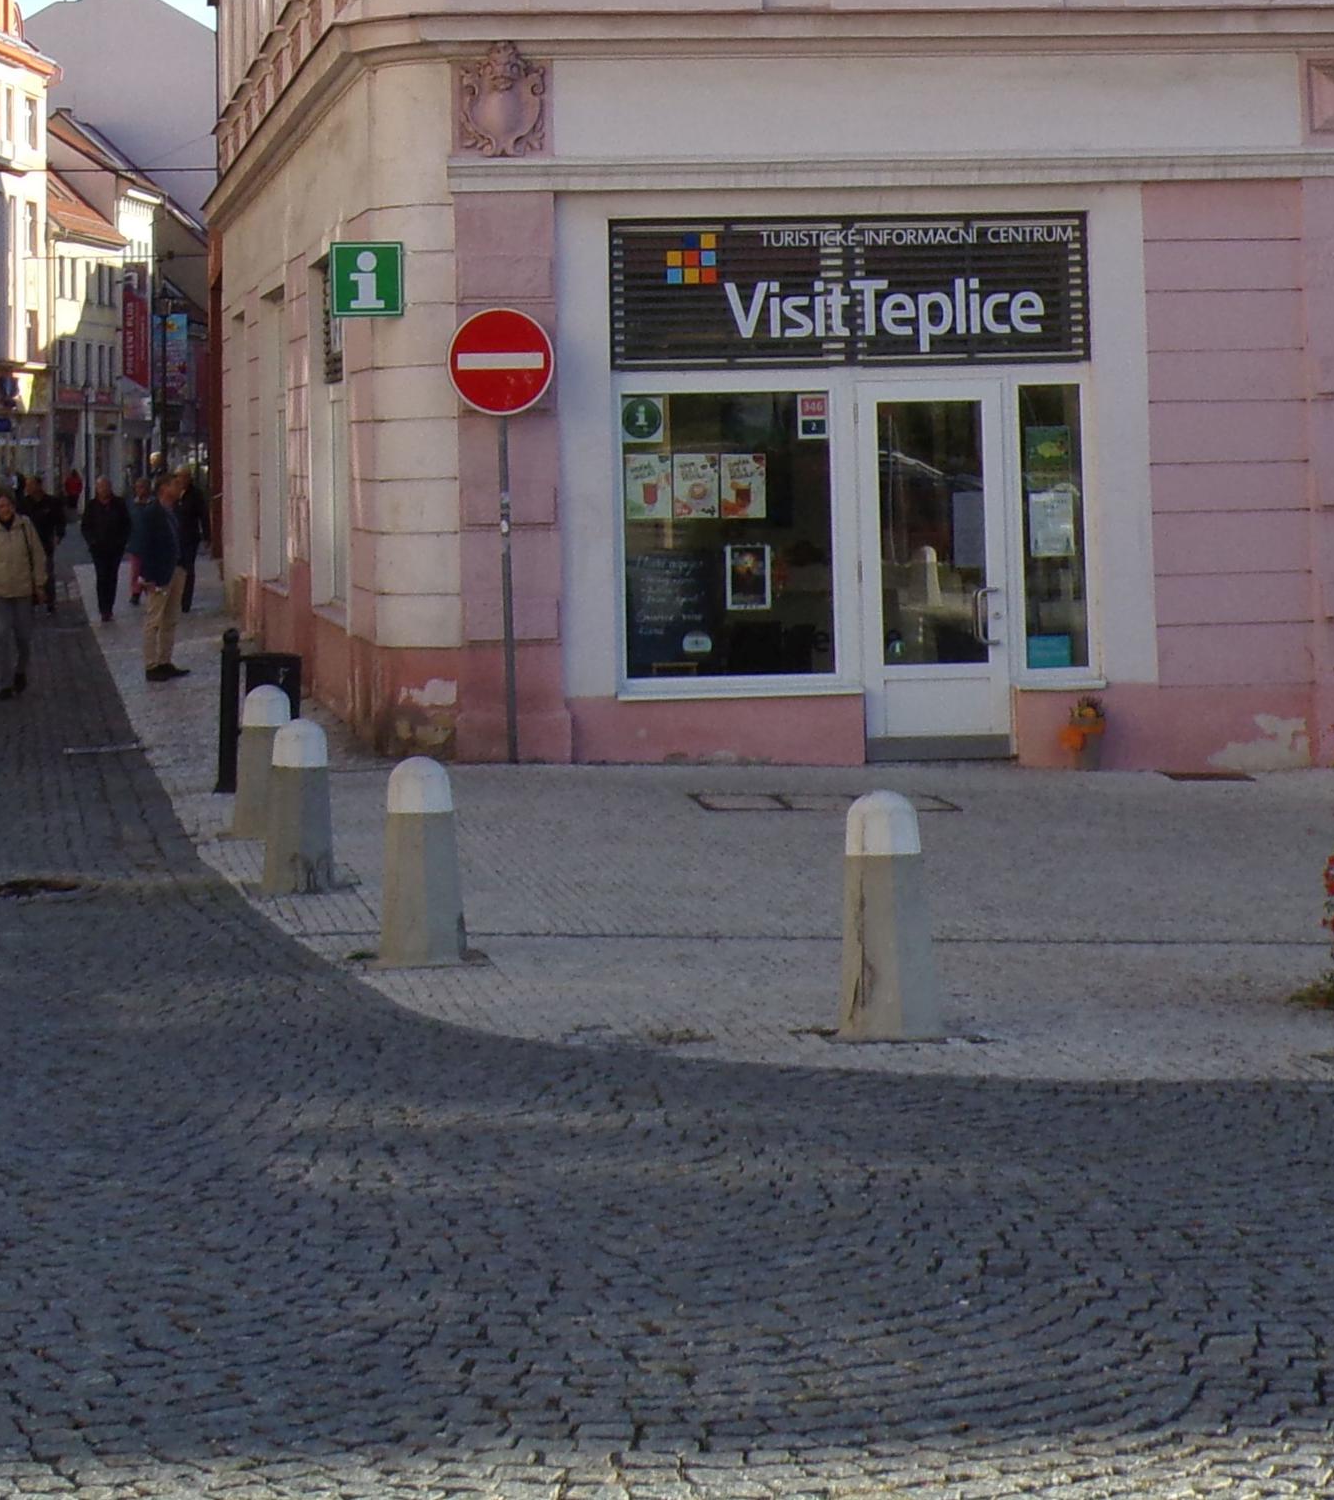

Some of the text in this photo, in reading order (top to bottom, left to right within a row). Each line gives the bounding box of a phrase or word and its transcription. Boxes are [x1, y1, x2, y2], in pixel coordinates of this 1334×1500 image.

[760, 227, 857, 247] TURISTICKÉ
[987, 225, 1074, 244] CENTRUM
[125, 301, 135, 375] PREVENT PLUS
[723, 277, 1045, 353] VisitTeplice
